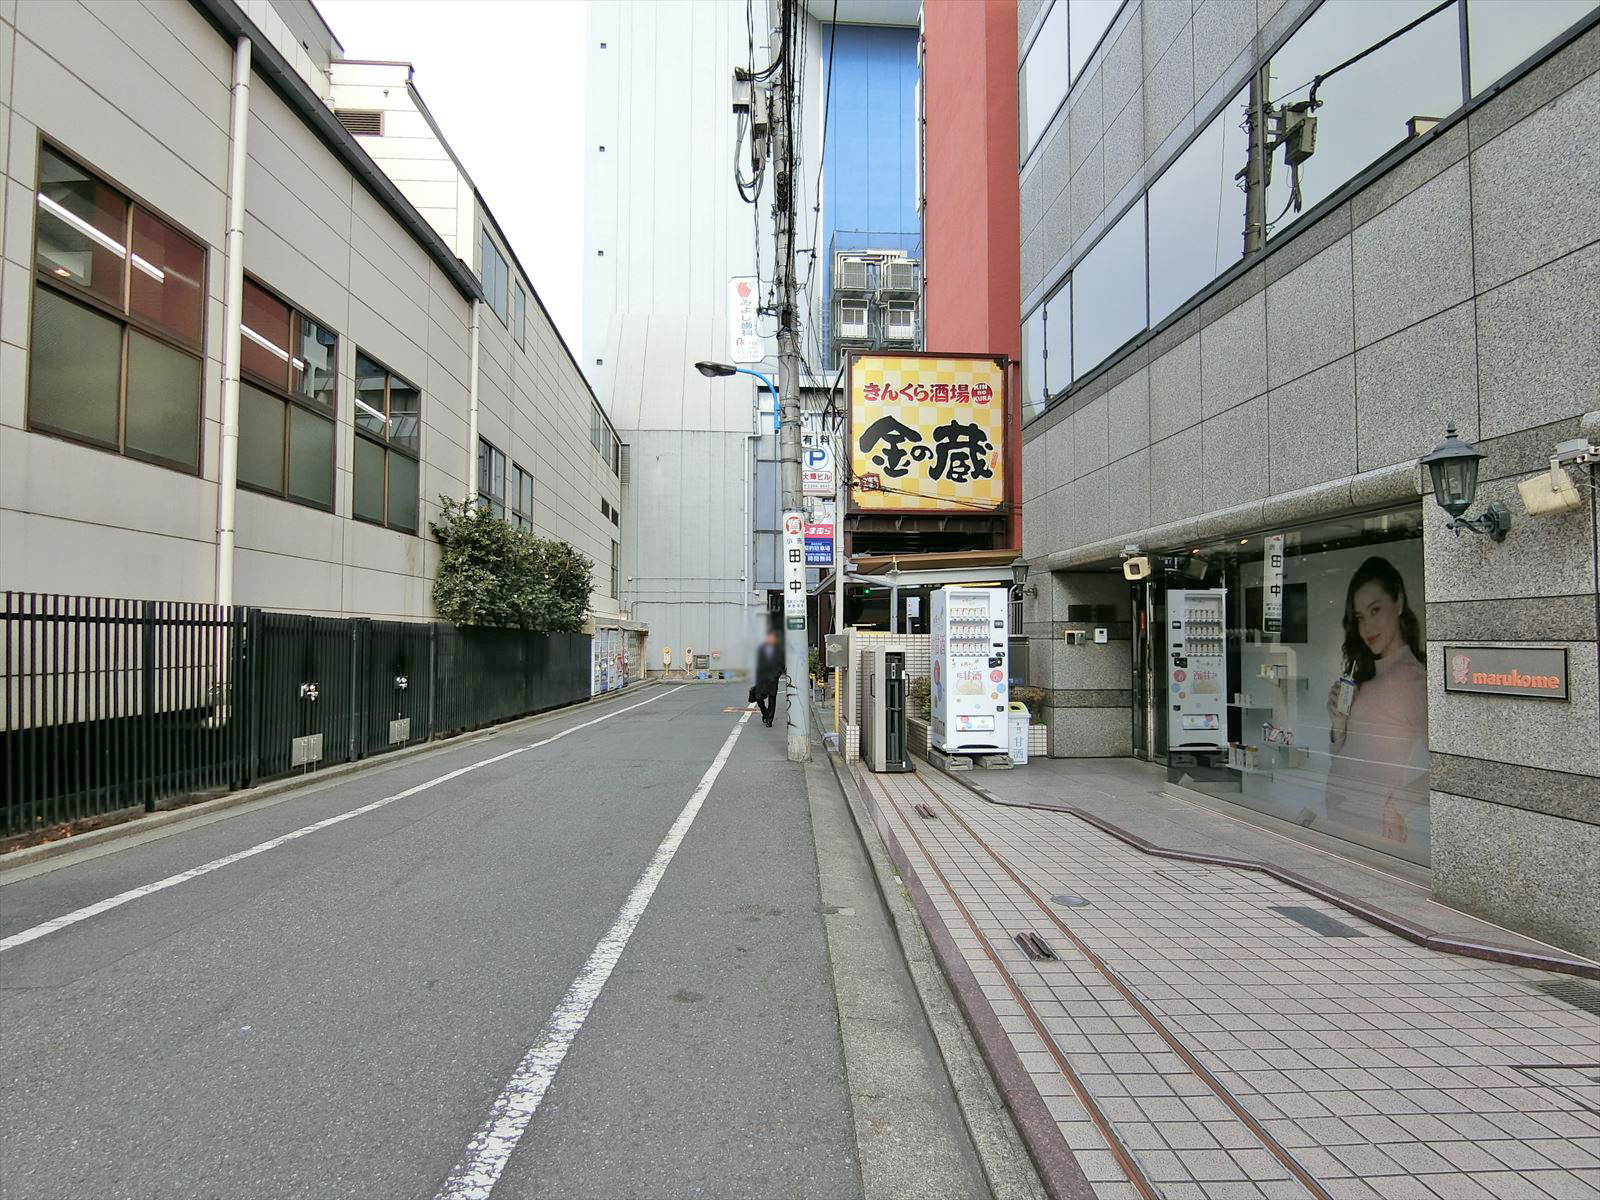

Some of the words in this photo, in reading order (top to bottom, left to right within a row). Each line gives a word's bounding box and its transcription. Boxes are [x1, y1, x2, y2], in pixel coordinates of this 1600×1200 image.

[863, 383, 969, 404] きんくら酒場
[810, 449, 826, 466] P
[859, 415, 994, 483] 金の蔵
[1472, 669, 1560, 689] marukome
